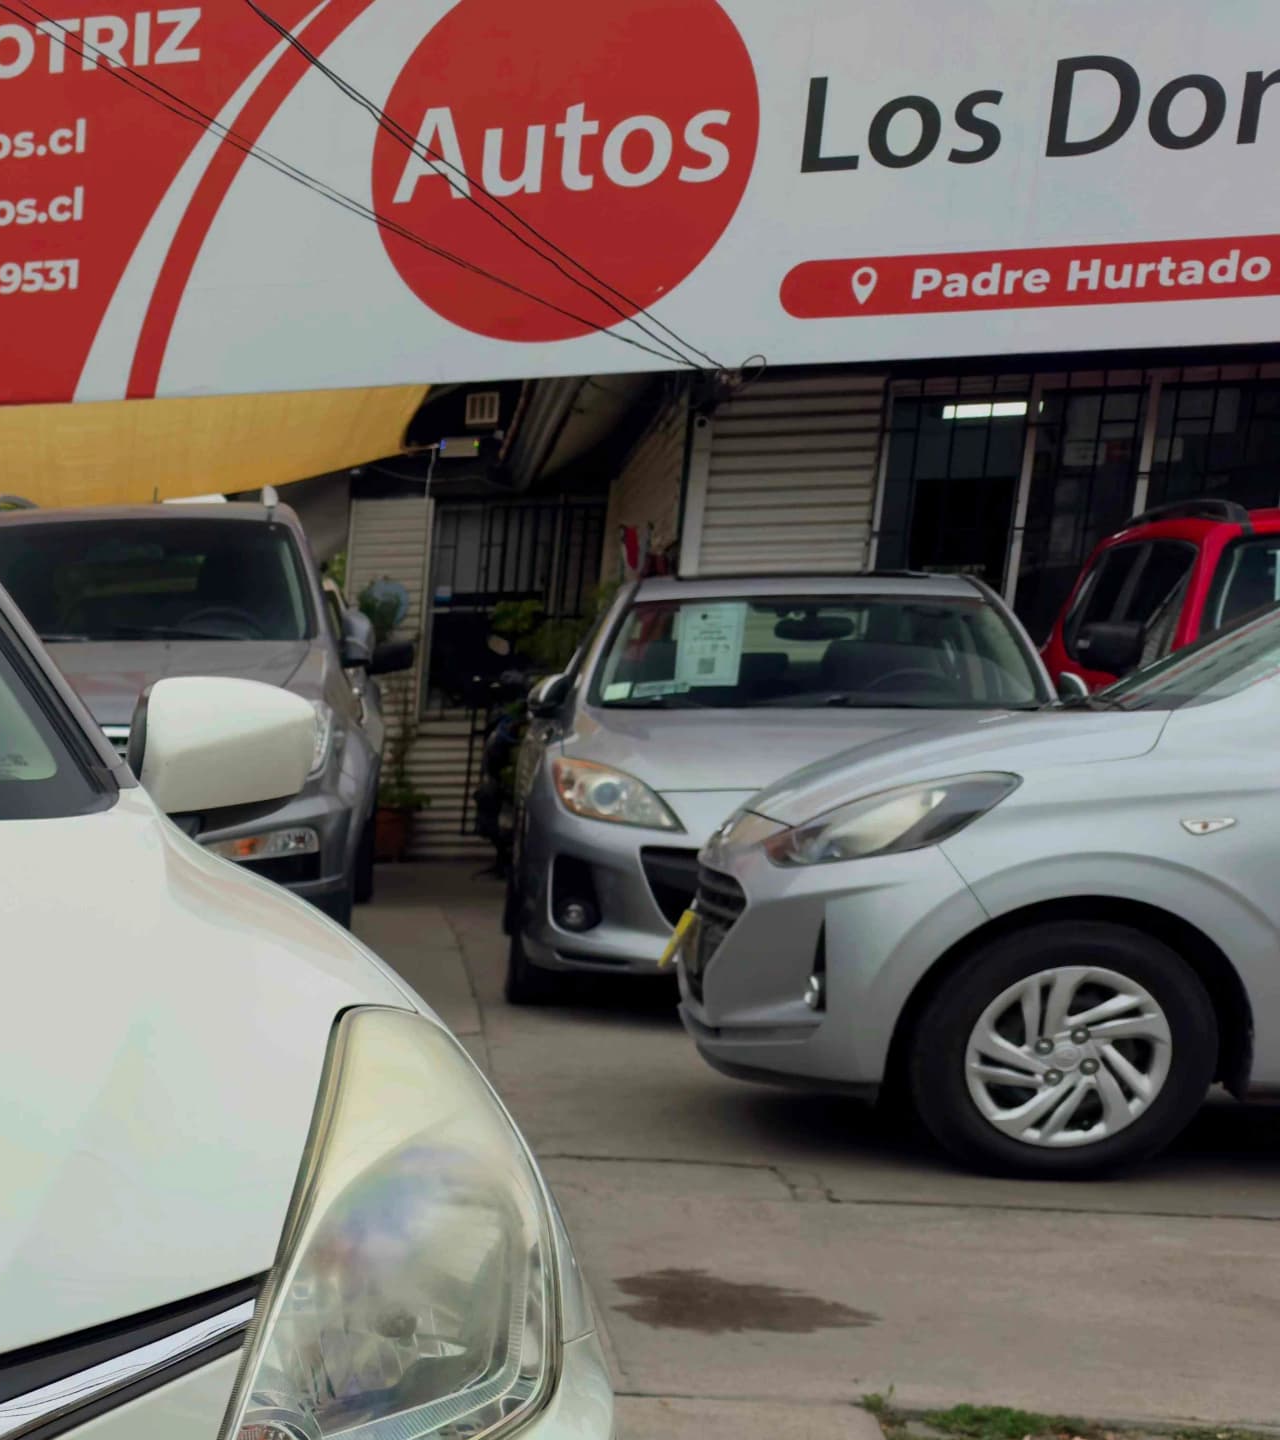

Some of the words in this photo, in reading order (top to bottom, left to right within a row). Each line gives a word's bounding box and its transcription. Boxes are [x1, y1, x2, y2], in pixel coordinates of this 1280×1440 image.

[392, 100, 732, 204] Autos
[800, 76, 1005, 174] Los
[911, 262, 1051, 300] Padre
[1066, 248, 1272, 292] Hurtado
